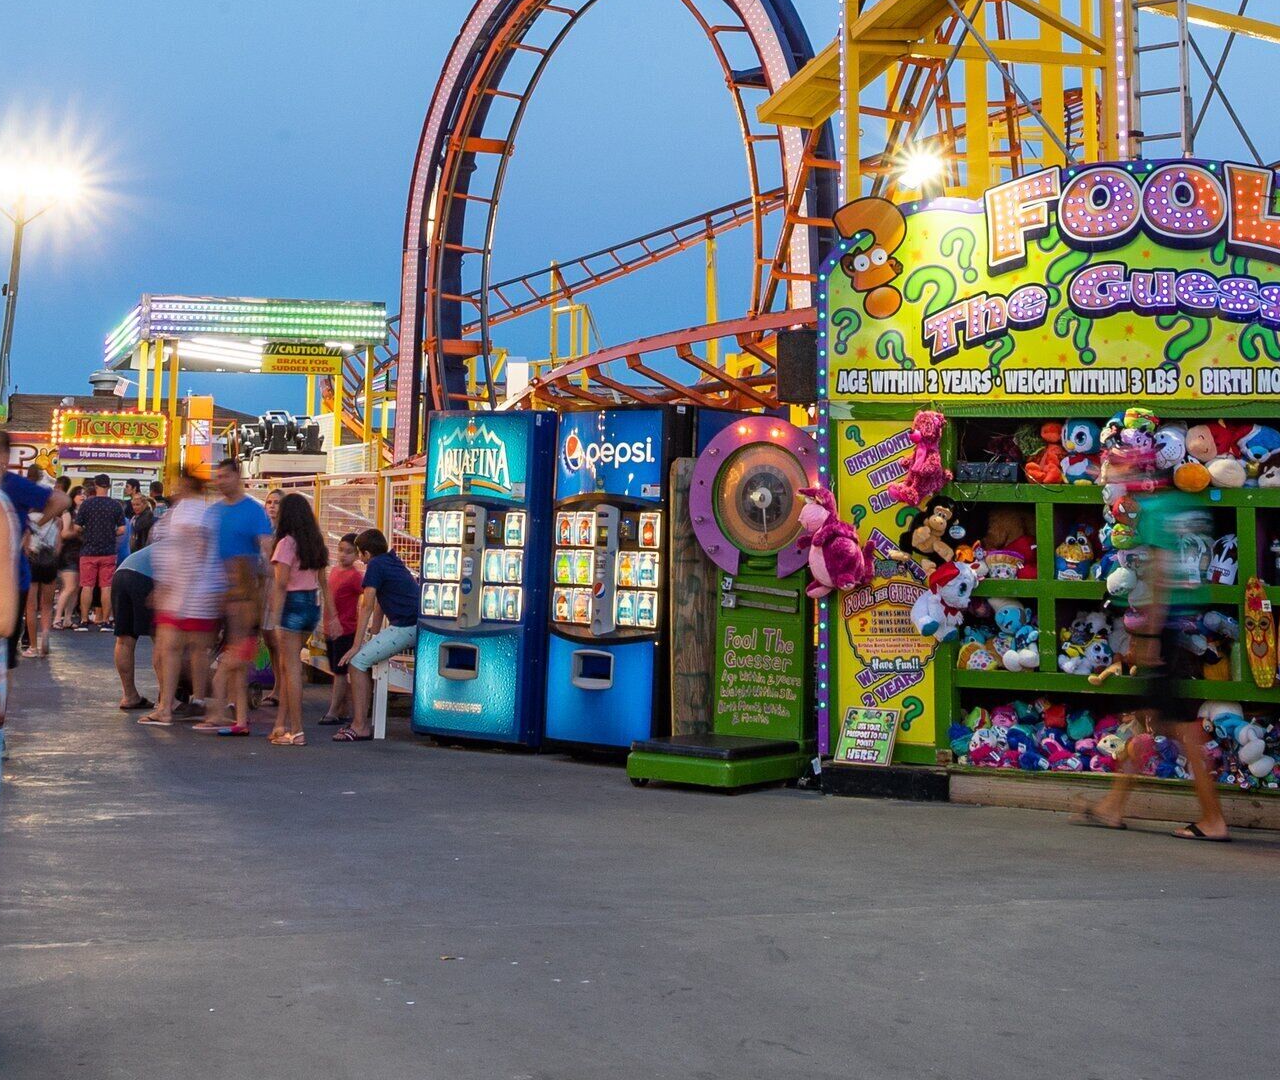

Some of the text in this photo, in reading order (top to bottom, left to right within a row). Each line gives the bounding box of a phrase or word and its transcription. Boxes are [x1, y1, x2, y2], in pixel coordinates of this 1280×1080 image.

[923, 284, 1049, 360] The
[278, 345, 327, 355] CAUTION
[837, 369, 868, 394] AGE
[870, 369, 925, 395] WITHIN
[927, 369, 939, 394] 2
[942, 369, 993, 394] YEARS
[1004, 369, 1065, 395] WEIGHT
[1069, 368, 1127, 395] WITHIN
[1129, 368, 1143, 395] 3
[1145, 368, 1178, 395] LBS
[1201, 367, 1254, 395] BIRTH
[68, 416, 160, 439] TICKETS
[434, 439, 513, 492] AQUAFINA
[845, 445, 880, 476] BIRTH
[869, 496, 882, 513] 2
[844, 586, 874, 617] FOOL
[724, 625, 795, 654] Fool The
[723, 650, 793, 672] Guesser
[872, 658, 919, 670] Have Fun!!
[846, 748, 880, 761] HERE!
